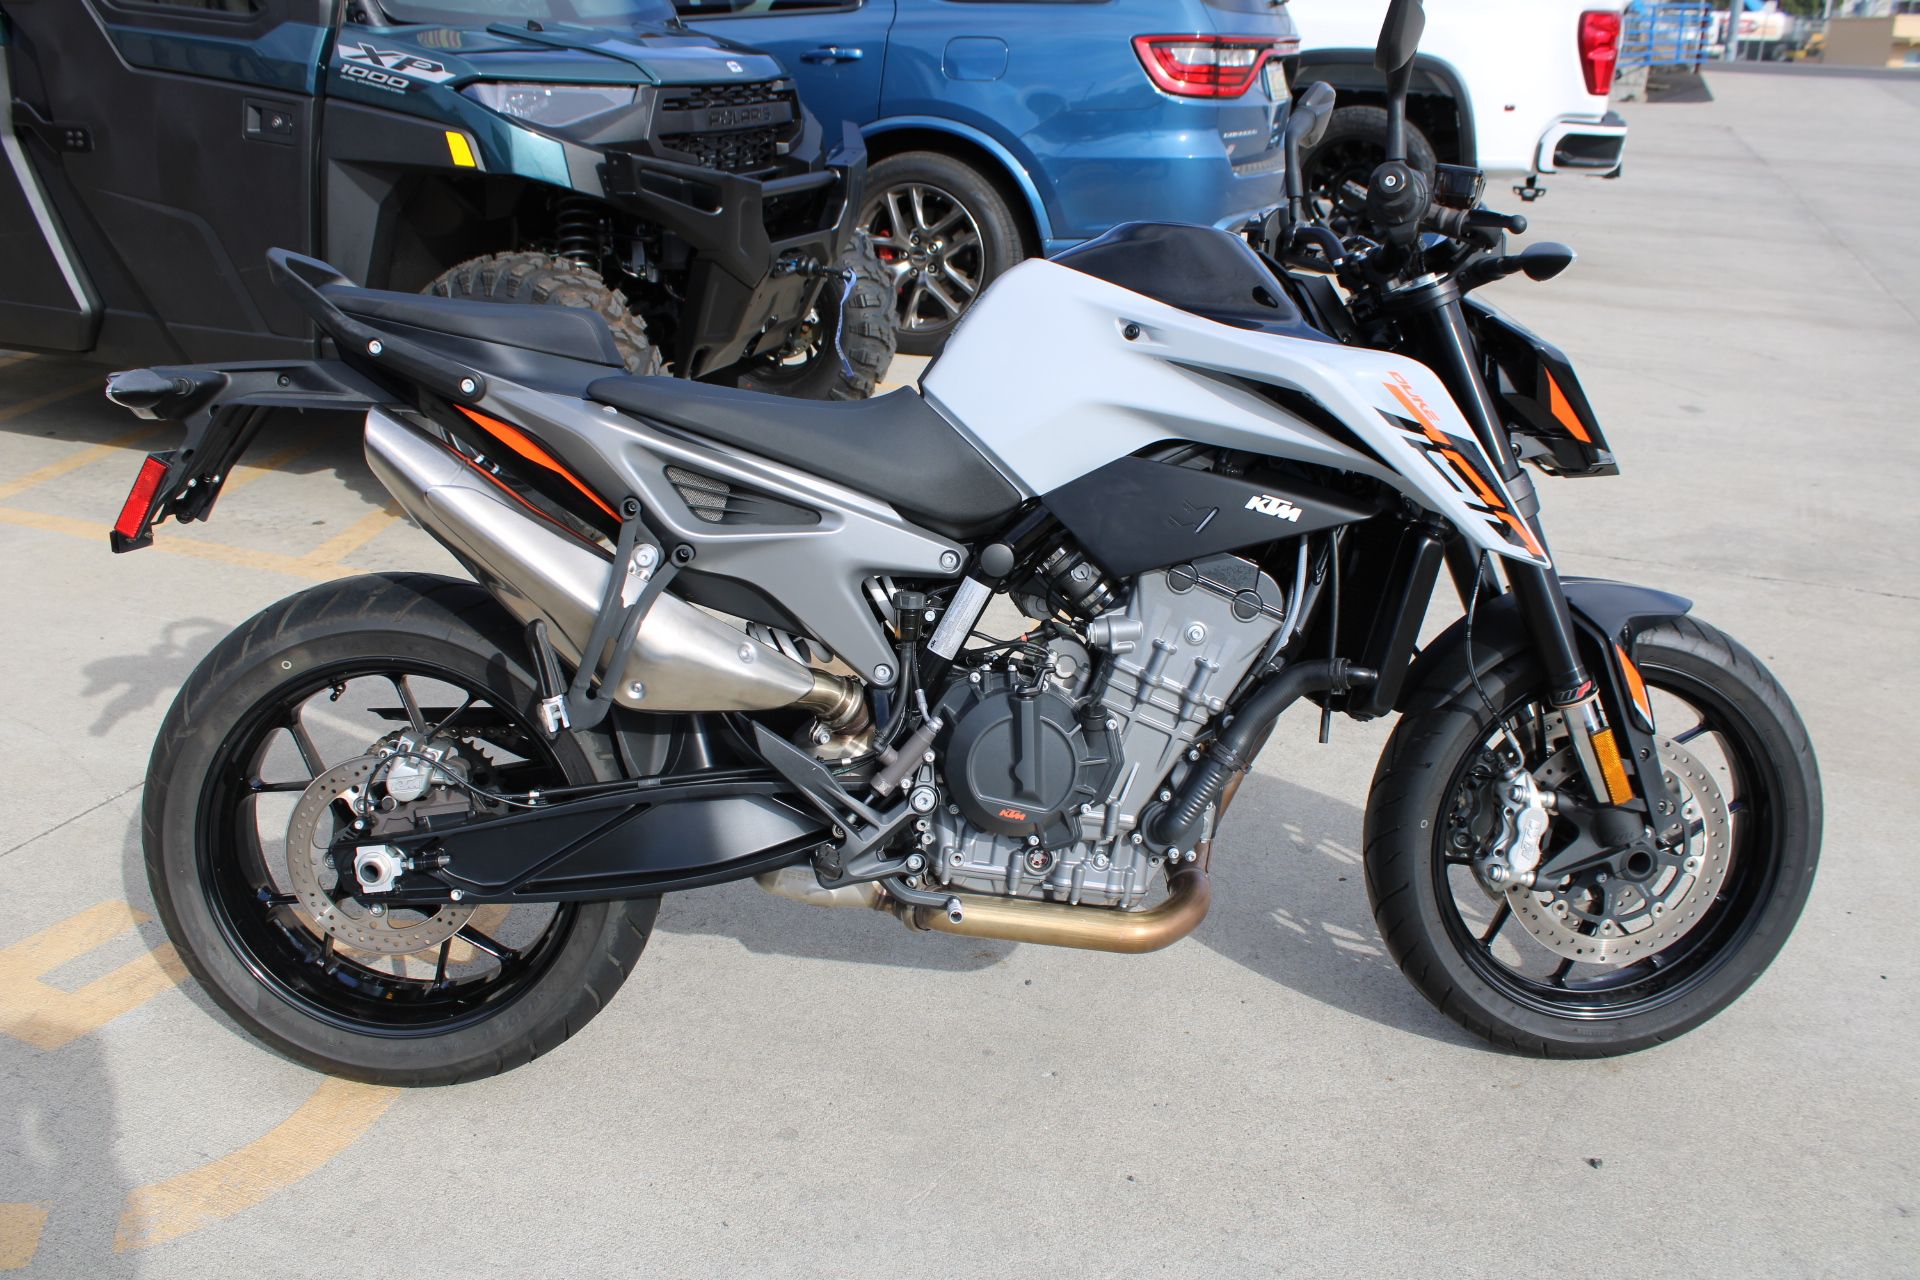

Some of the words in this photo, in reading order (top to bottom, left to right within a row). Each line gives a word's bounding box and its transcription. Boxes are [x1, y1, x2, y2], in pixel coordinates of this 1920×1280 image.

[340, 63, 410, 89] 1000
[709, 108, 771, 127] POLARIS
[1387, 371, 1441, 422] DUKE
[1244, 494, 1303, 523] KTM
[998, 808, 1027, 821] KTM
